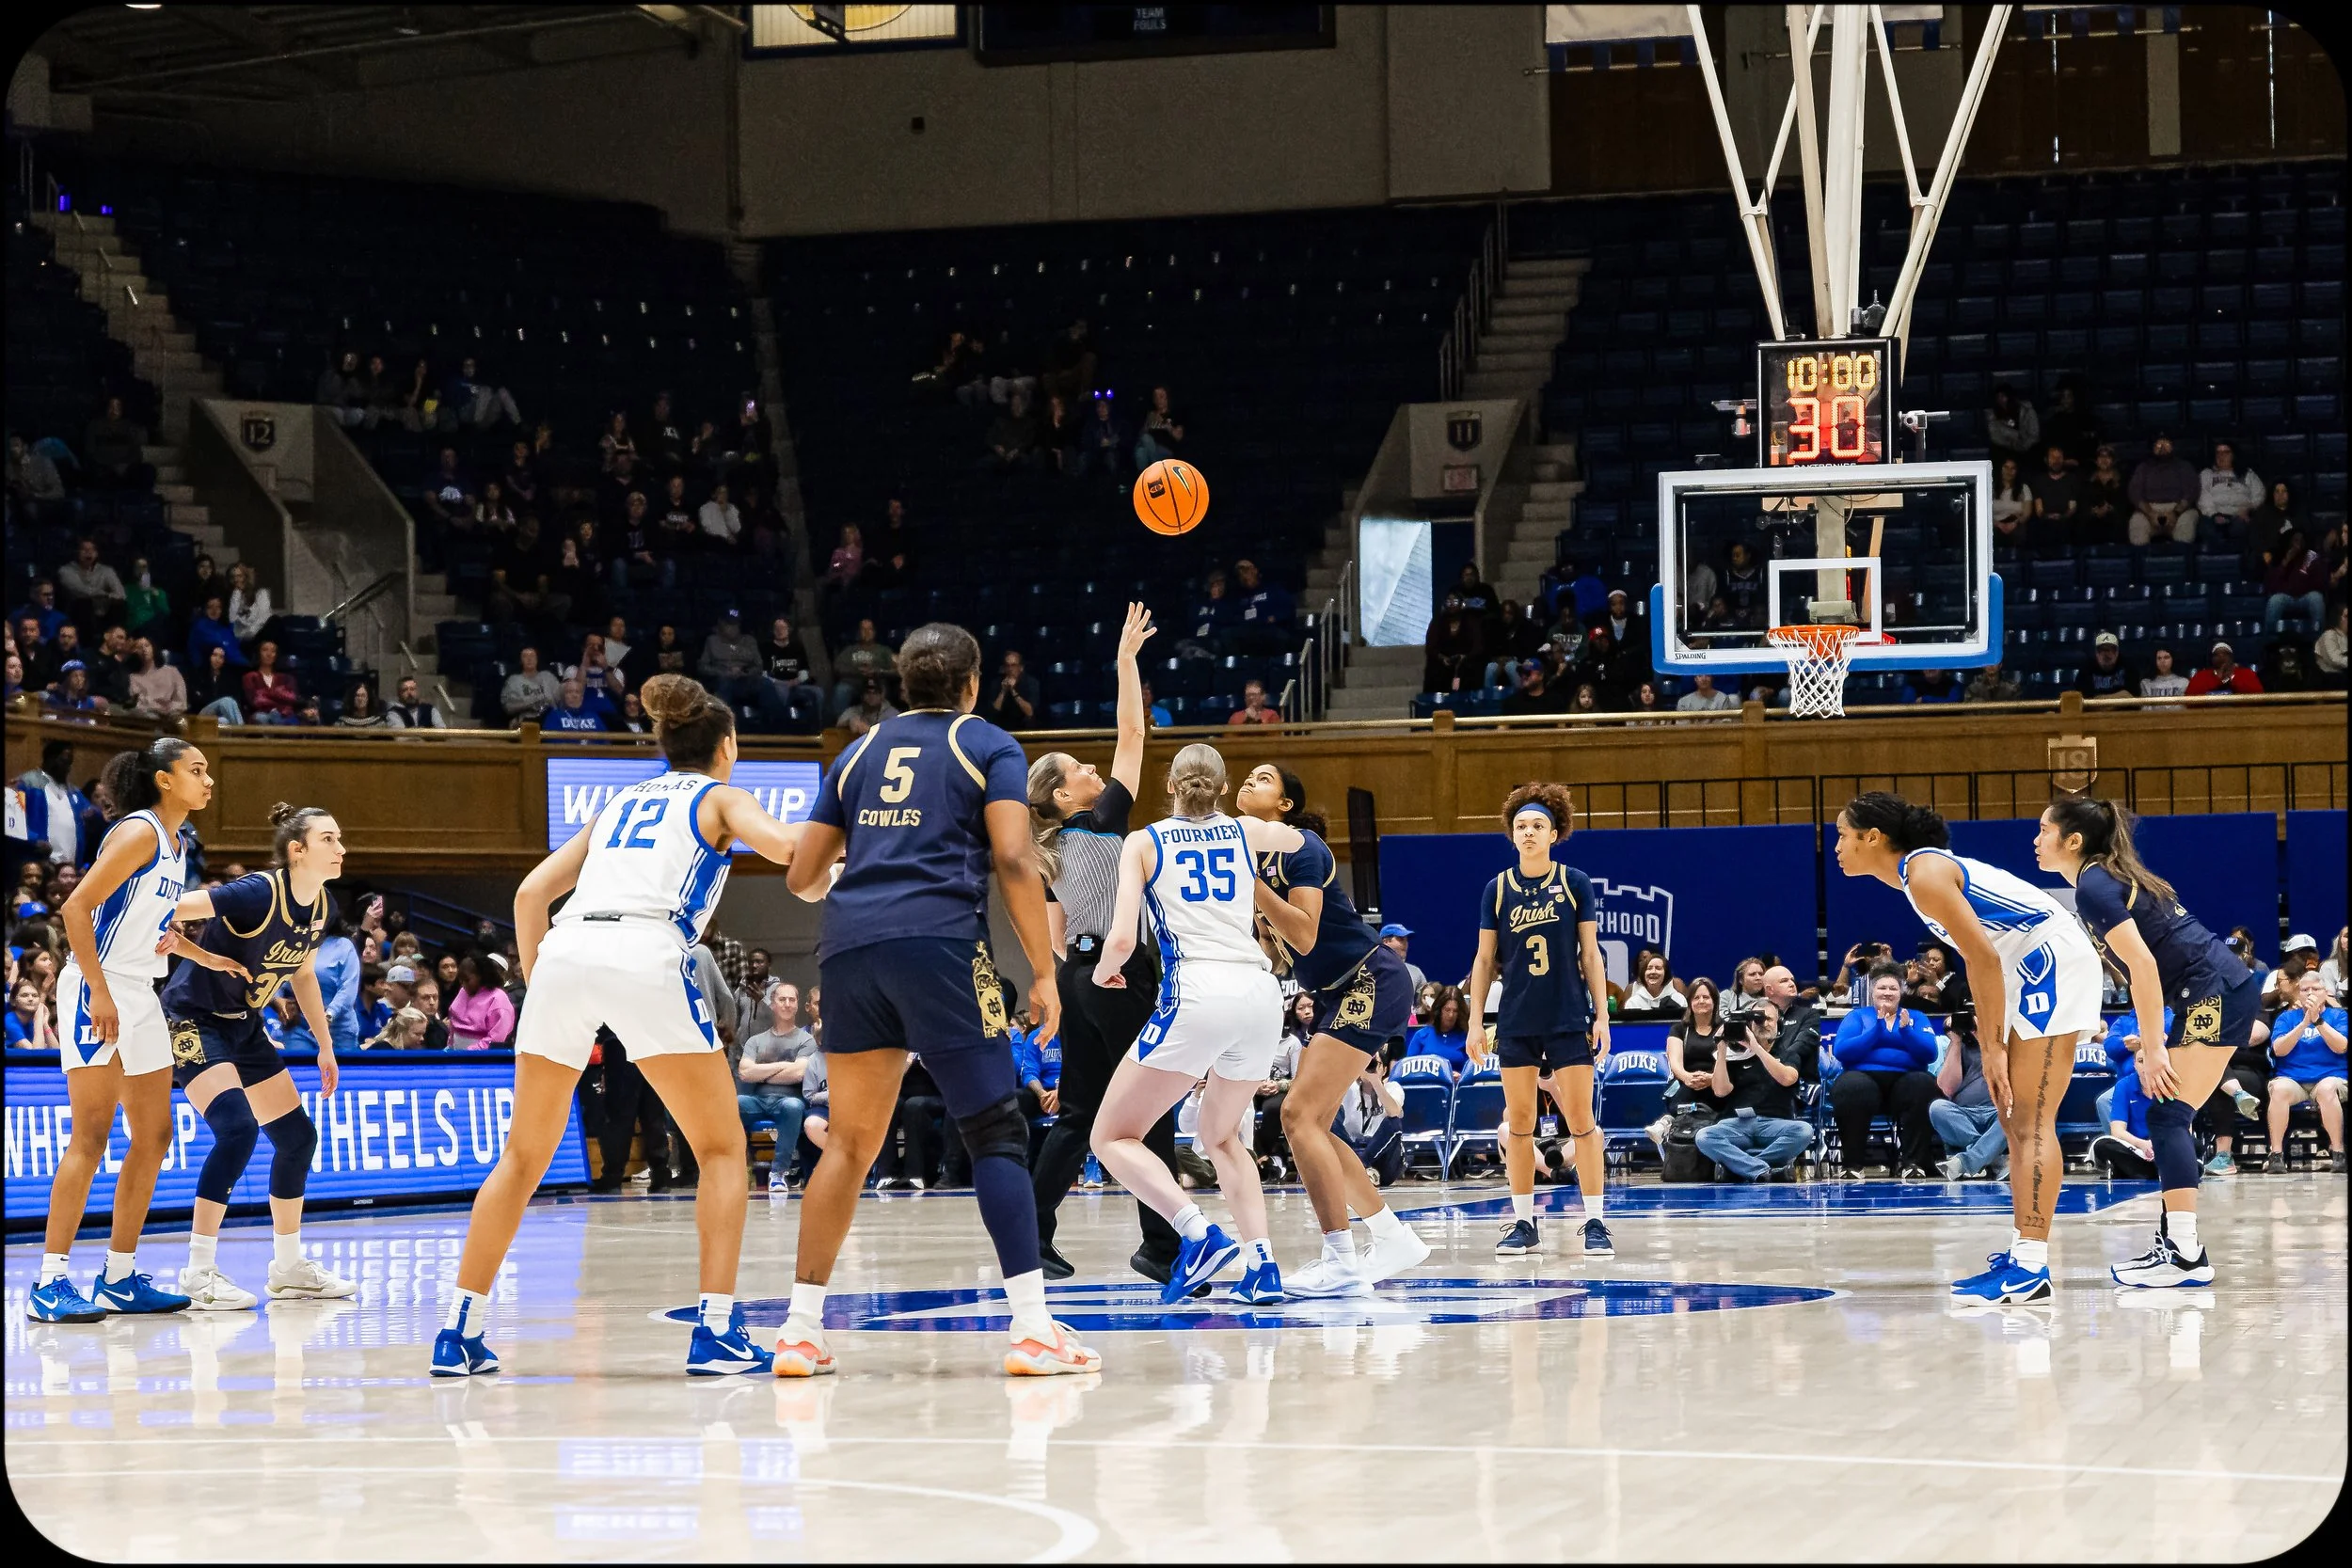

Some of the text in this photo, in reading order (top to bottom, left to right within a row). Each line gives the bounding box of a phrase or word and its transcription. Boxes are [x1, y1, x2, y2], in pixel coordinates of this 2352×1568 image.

[1136, 8, 1164, 18] TEAM
[1134, 19, 1167, 30] FOULS
[1787, 355, 1876, 391] 10:00
[249, 423, 270, 444] 12
[1788, 395, 1866, 460] 30
[560, 717, 596, 729] DUKE
[879, 746, 922, 803] 5
[605, 798, 669, 849] 12
[857, 808, 922, 827] COWLES
[1160, 824, 1241, 845] FOURNIER
[1175, 847, 1236, 903] 35
[155, 876, 184, 902] DUK
[1595, 897, 1604, 909] HE
[1509, 900, 1559, 932] Irish
[1525, 934, 1550, 976] 3
[1401, 1056, 1441, 1077] DUKE
[1618, 1053, 1658, 1073] DUKE
[2074, 1047, 2107, 1067] UKE
[161, 1102, 197, 1171] P
